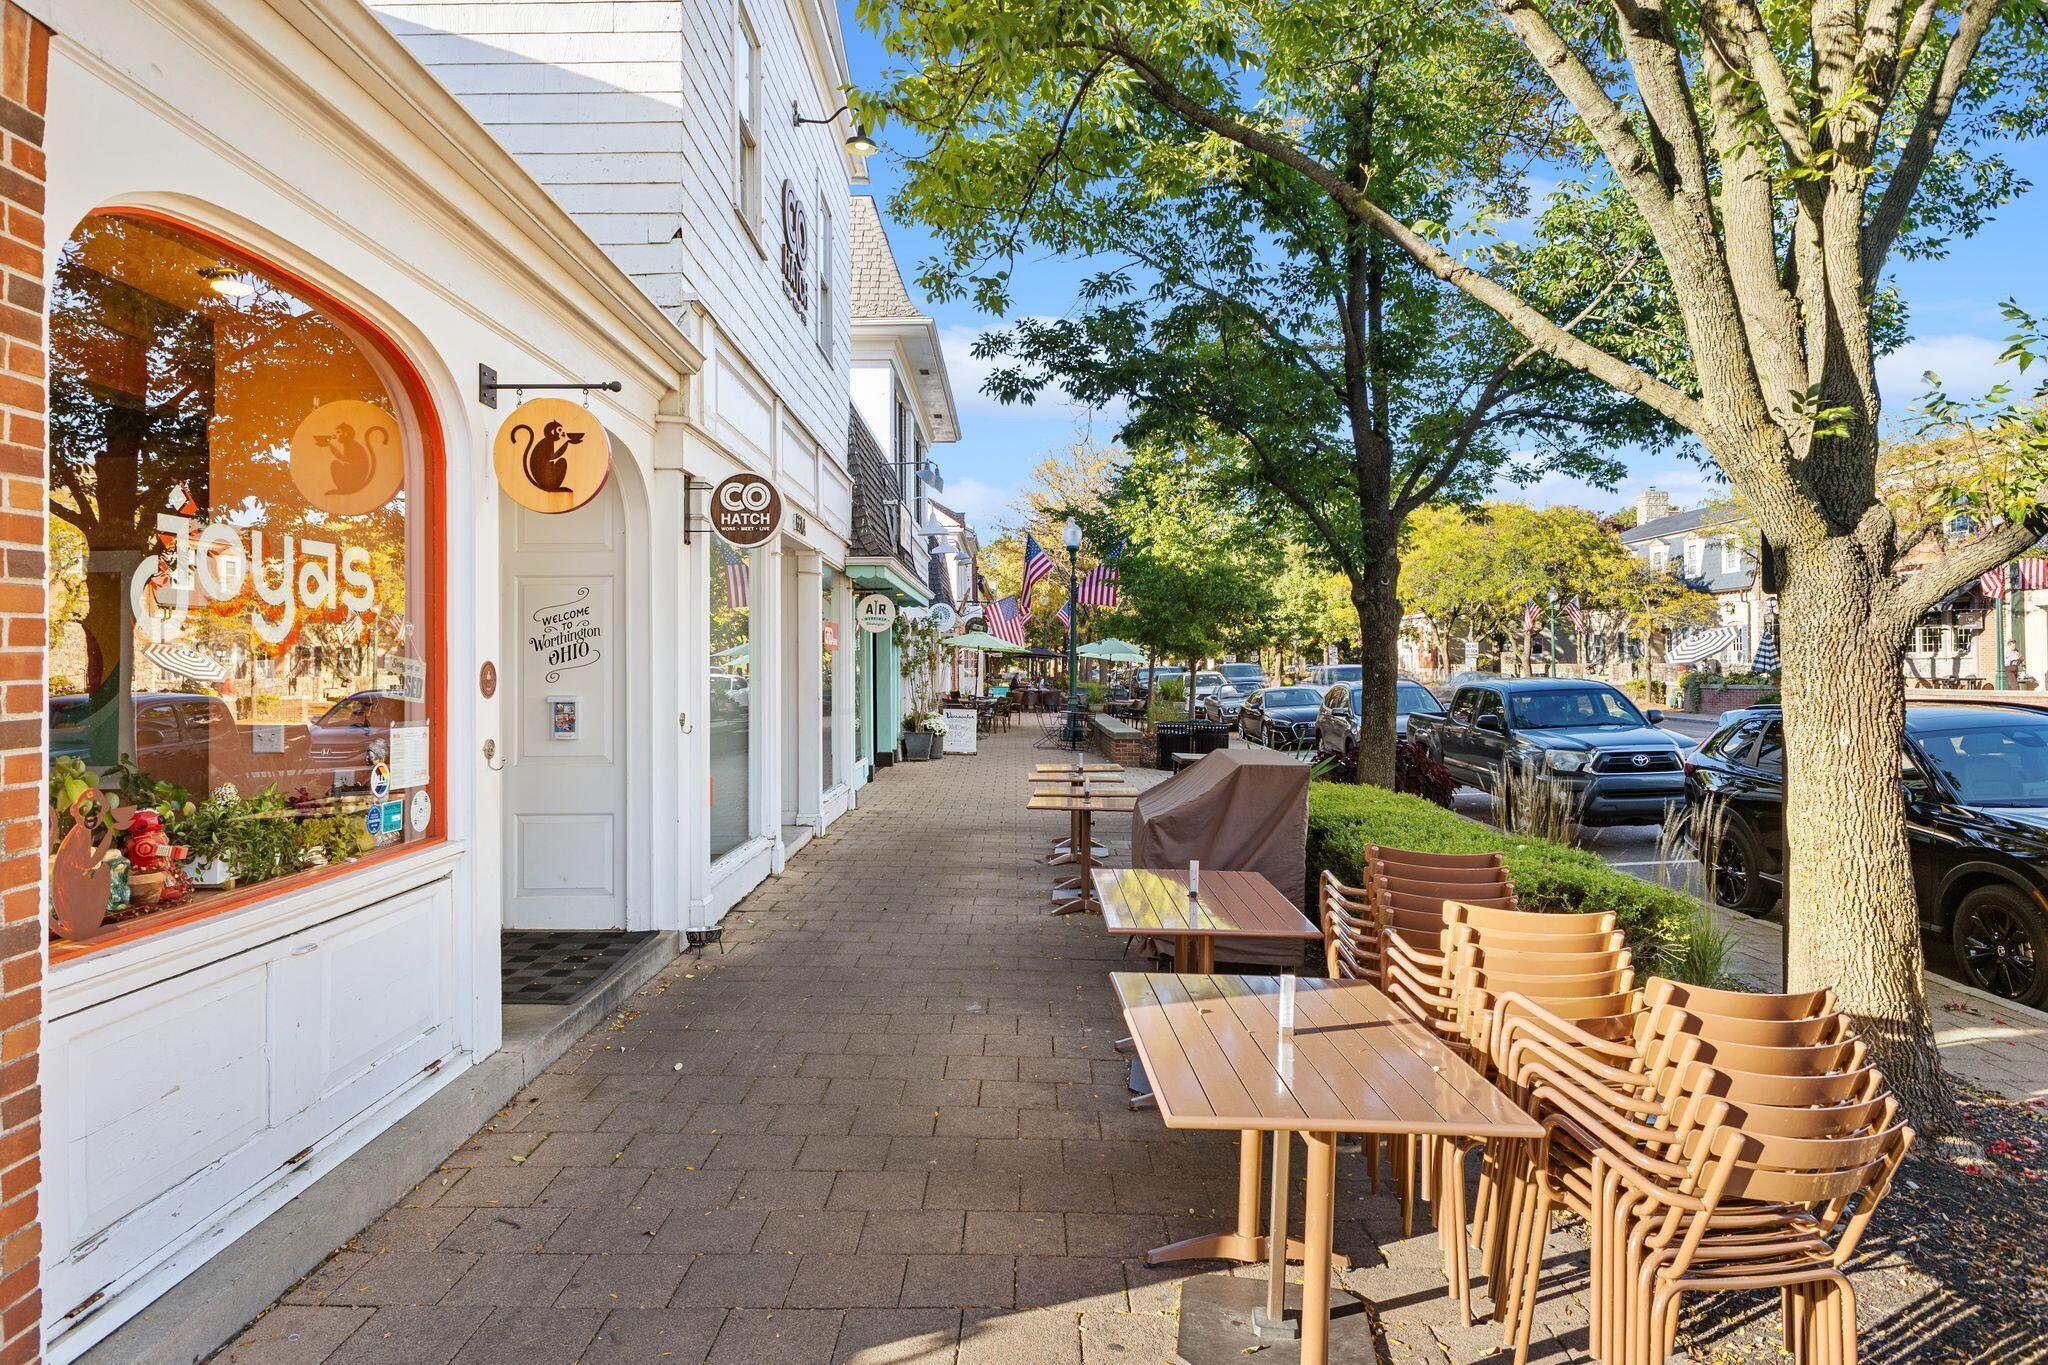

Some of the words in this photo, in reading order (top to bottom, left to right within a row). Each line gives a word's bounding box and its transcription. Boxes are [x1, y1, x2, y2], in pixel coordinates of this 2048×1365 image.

[720, 482, 771, 512] CO
[721, 513, 771, 525] HATCH
[130, 513, 375, 644] Joyas
[542, 606, 590, 626] WELCOME
[562, 621, 573, 631] TO
[529, 626, 601, 652] Worthington
[549, 641, 589, 666] OHIO
